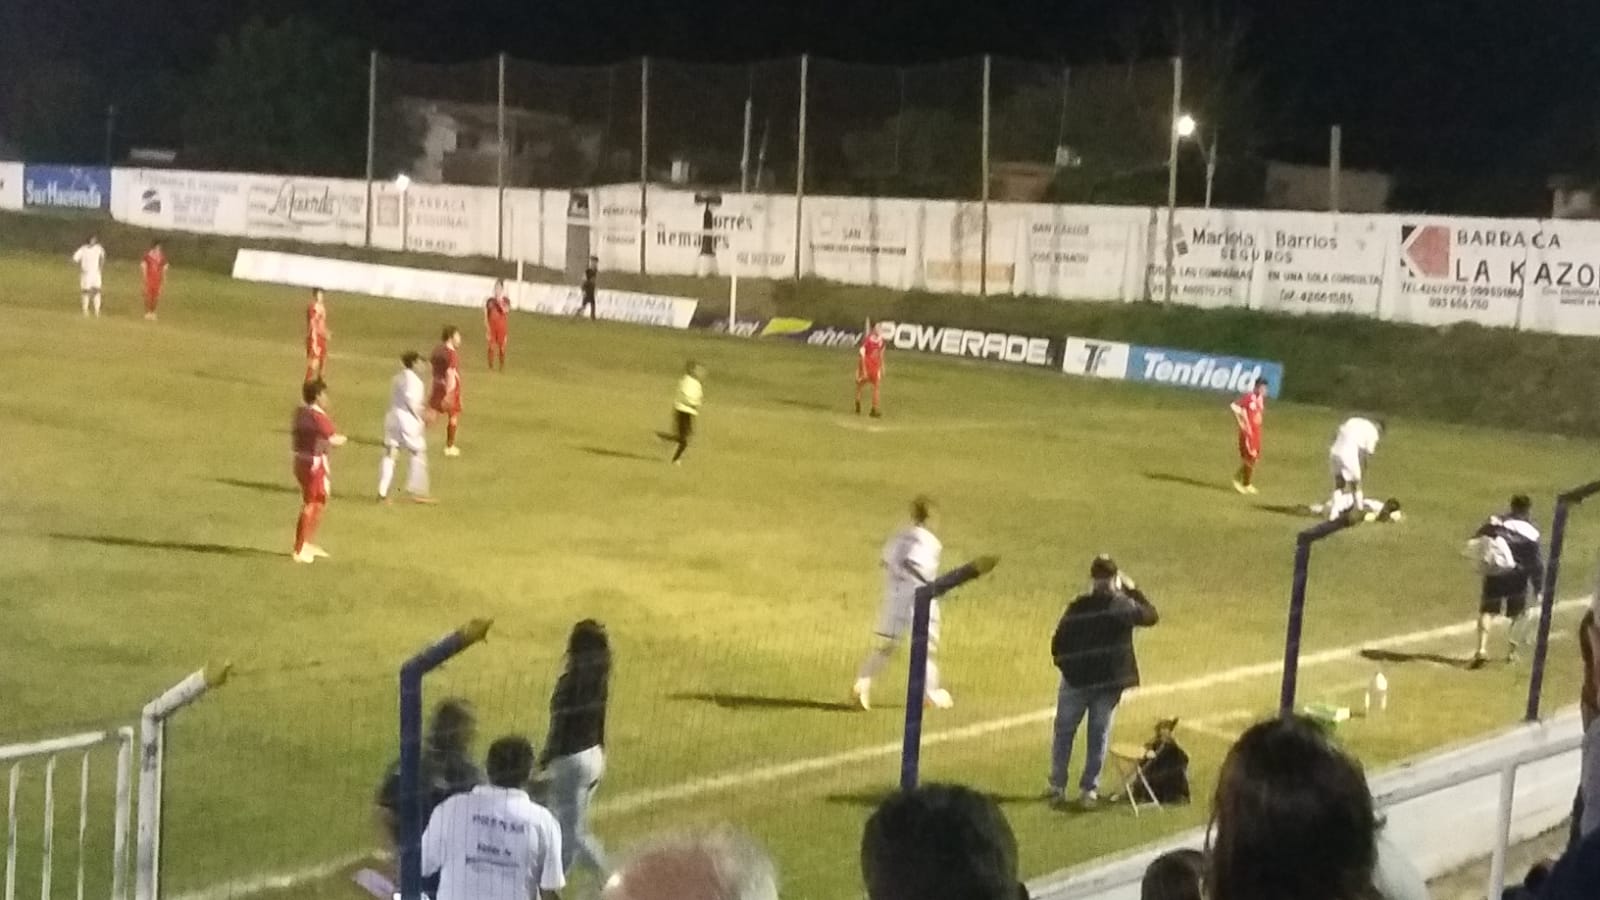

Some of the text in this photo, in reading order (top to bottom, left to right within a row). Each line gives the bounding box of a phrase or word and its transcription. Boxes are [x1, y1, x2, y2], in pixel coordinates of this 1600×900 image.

[1032, 223, 1052, 235] SAN
[1192, 227, 1338, 250] Mariela Barrios
[1457, 229, 1561, 250] BARRACA
[1220, 248, 1293, 264] SEGUROS
[1283, 271, 1304, 283] UNA
[1456, 258, 1600, 289] LA KAZO
[876, 320, 1050, 365] POWERADE
[1144, 352, 1262, 393] Tenfield
